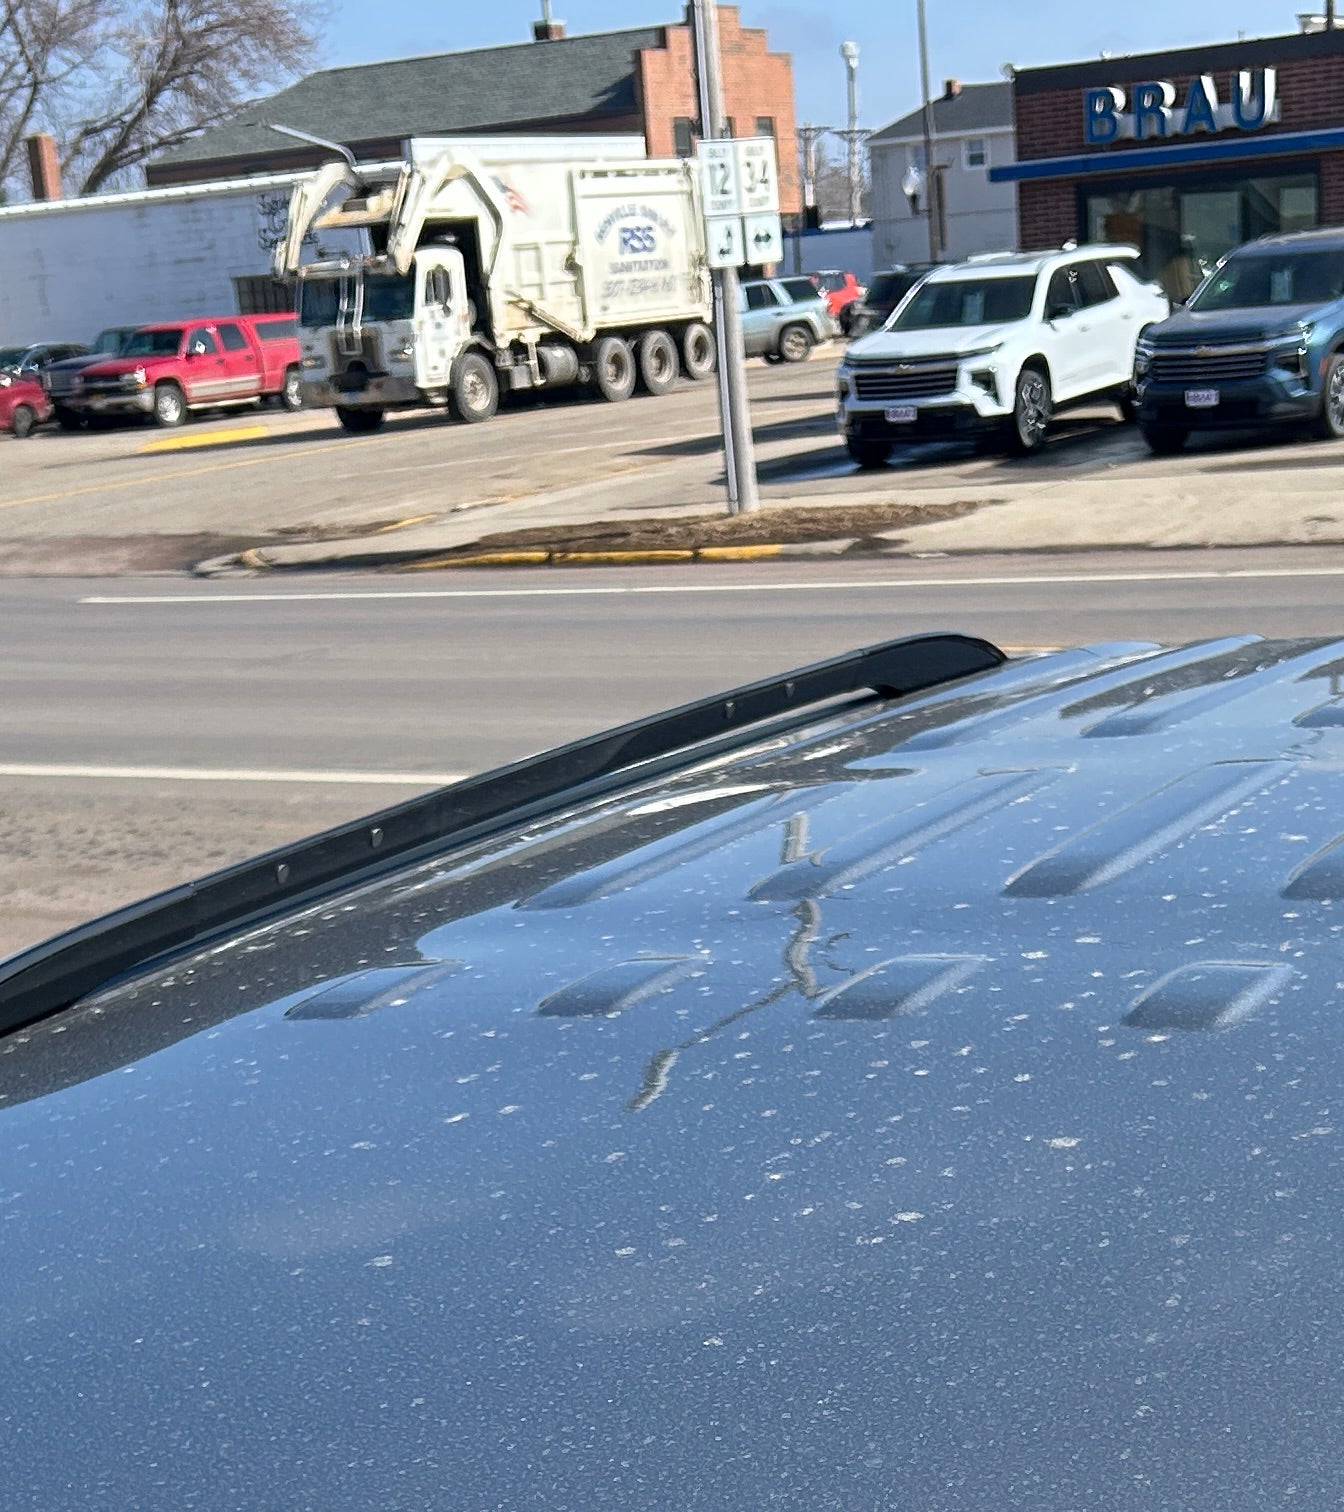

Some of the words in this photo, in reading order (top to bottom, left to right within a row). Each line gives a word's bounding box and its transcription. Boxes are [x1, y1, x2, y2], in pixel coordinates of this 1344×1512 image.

[1084, 66, 1276, 144] BRAU
[707, 161, 732, 196] 12
[743, 159, 772, 194] 34
